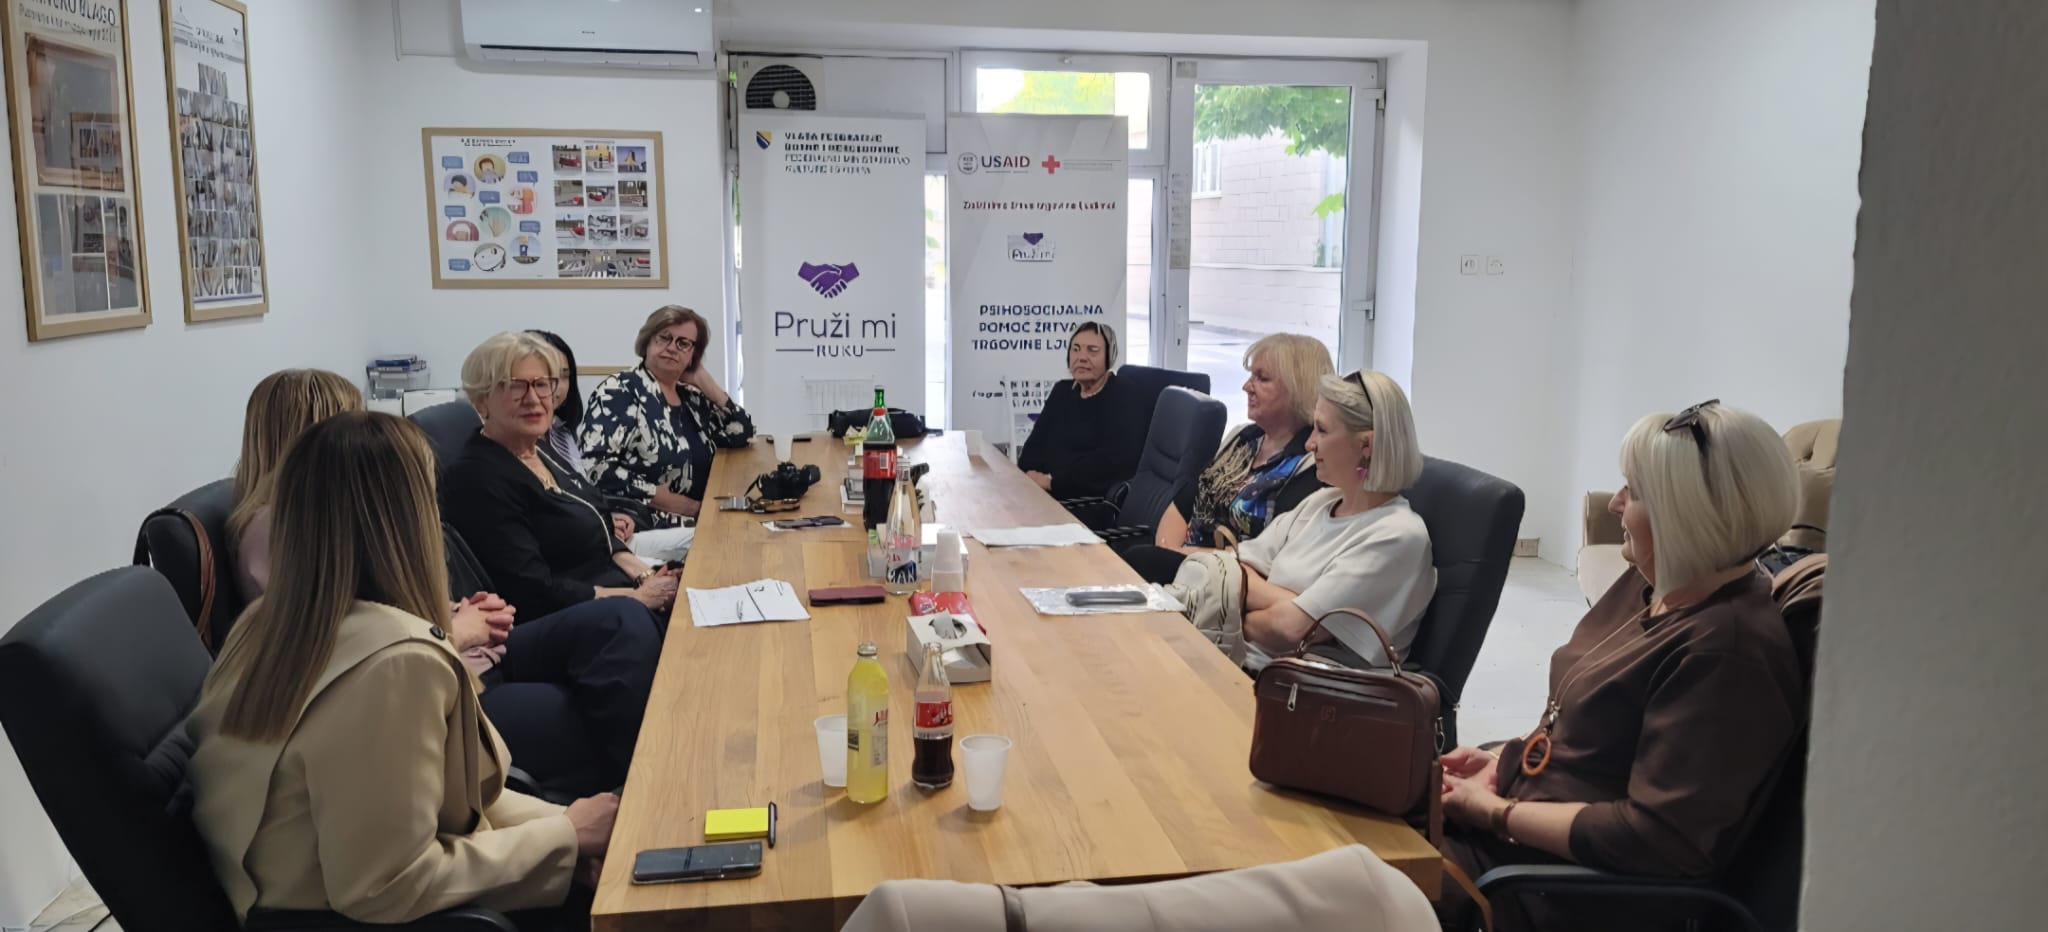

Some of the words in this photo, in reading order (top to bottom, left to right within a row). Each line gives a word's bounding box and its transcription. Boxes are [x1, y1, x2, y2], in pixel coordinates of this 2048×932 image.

[981, 155, 1030, 168] USAID
[979, 304, 1104, 316] PSIHOSOCIJALNA
[775, 312, 850, 338] Pruži
[862, 313, 896, 338] mi
[1034, 318, 1078, 333] ŽRTVA
[972, 339, 1042, 350] TRGOVINE
[816, 345, 864, 357] RUKU
